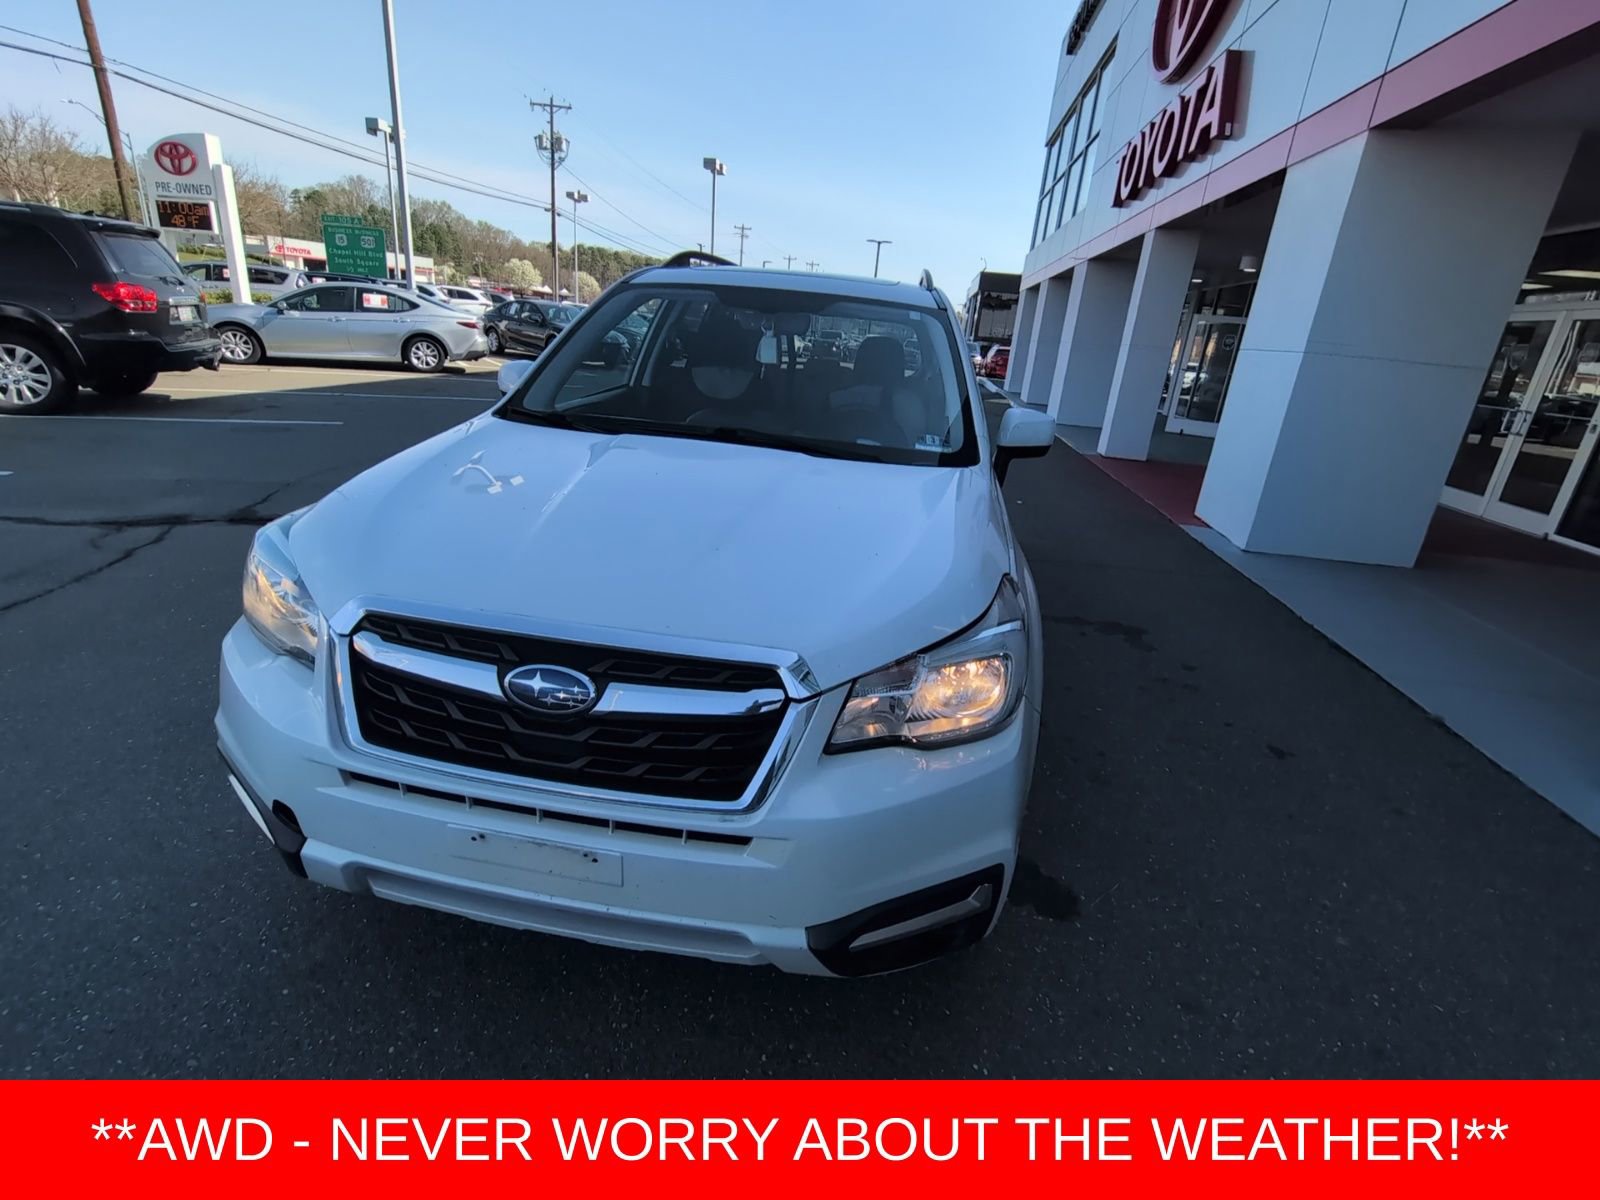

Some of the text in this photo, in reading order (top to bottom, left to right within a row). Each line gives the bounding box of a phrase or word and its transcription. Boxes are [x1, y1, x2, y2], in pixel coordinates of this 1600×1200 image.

[1112, 48, 1241, 208] TOYOTA
[154, 181, 212, 196] PRE-OWNED
[362, 238, 375, 247] 501
[286, 247, 311, 255] TOYOTA
[328, 247, 352, 256] Chapel
[353, 249, 367, 257] Hill
[357, 258, 380, 267] Square
